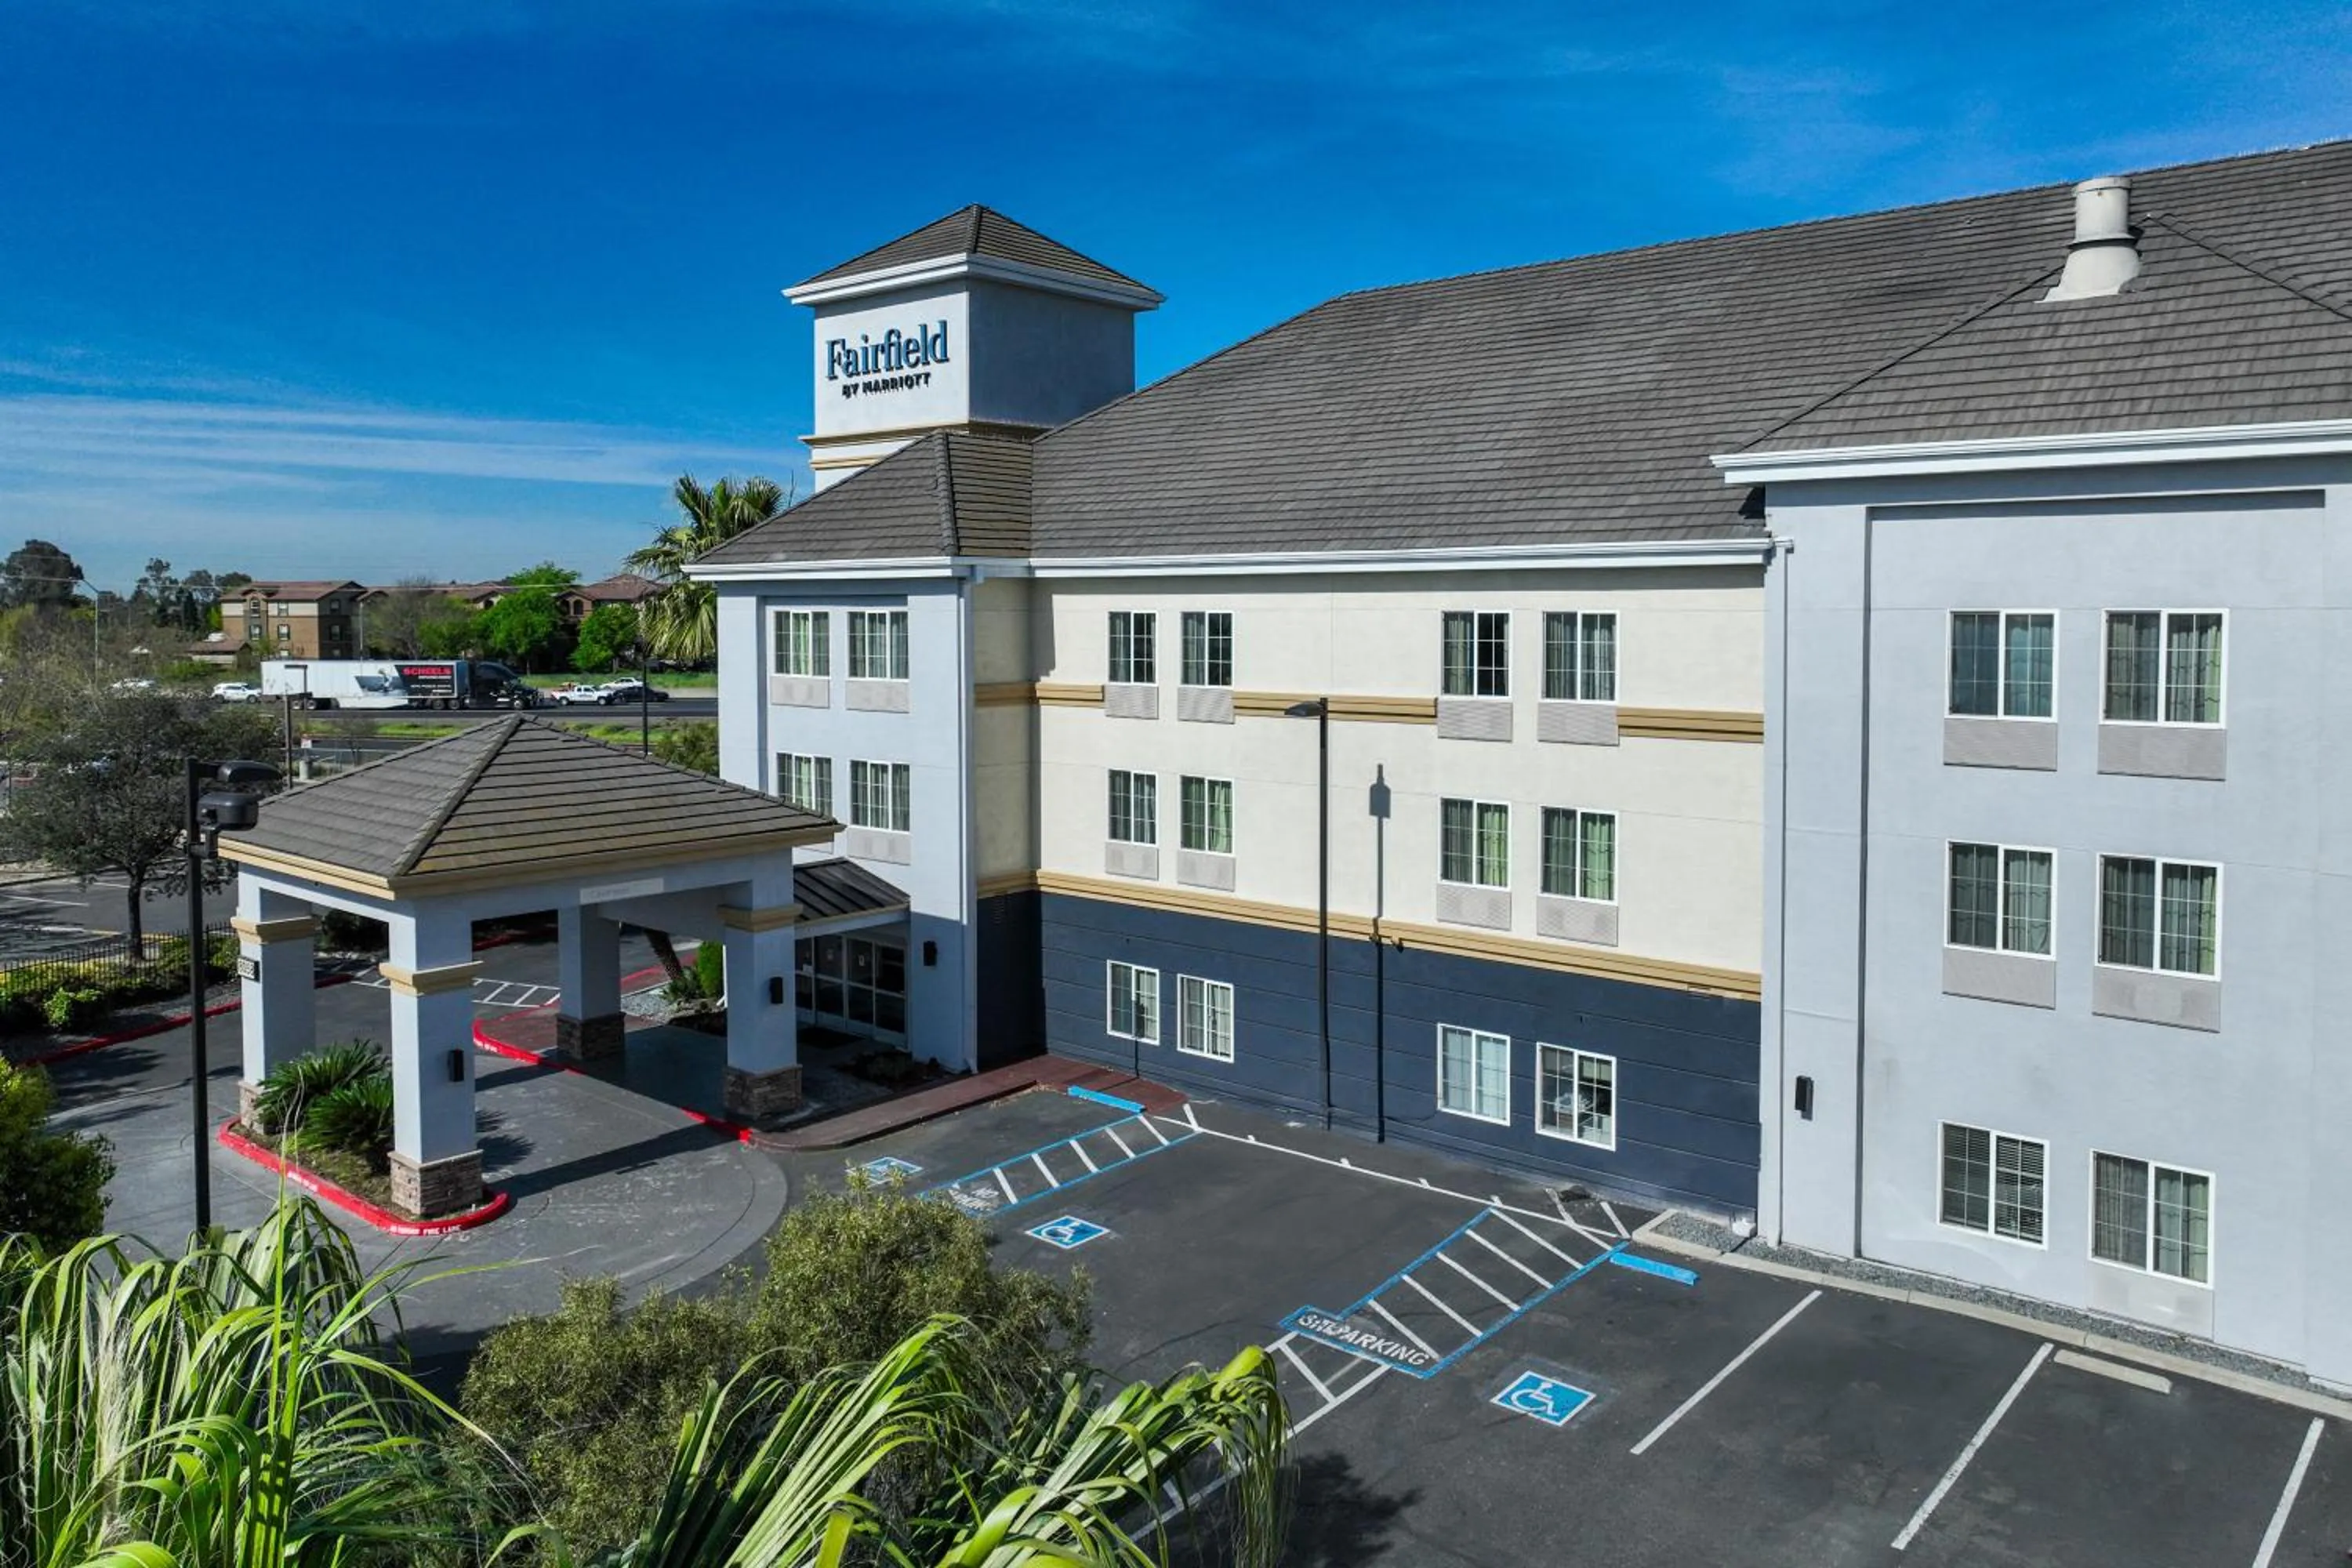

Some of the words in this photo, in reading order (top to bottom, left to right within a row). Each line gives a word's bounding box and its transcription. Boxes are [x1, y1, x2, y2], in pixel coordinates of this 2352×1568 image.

[826, 320, 949, 380] Fairfield
[842, 383, 860, 399] BY
[862, 372, 931, 394] MARRIOTT
